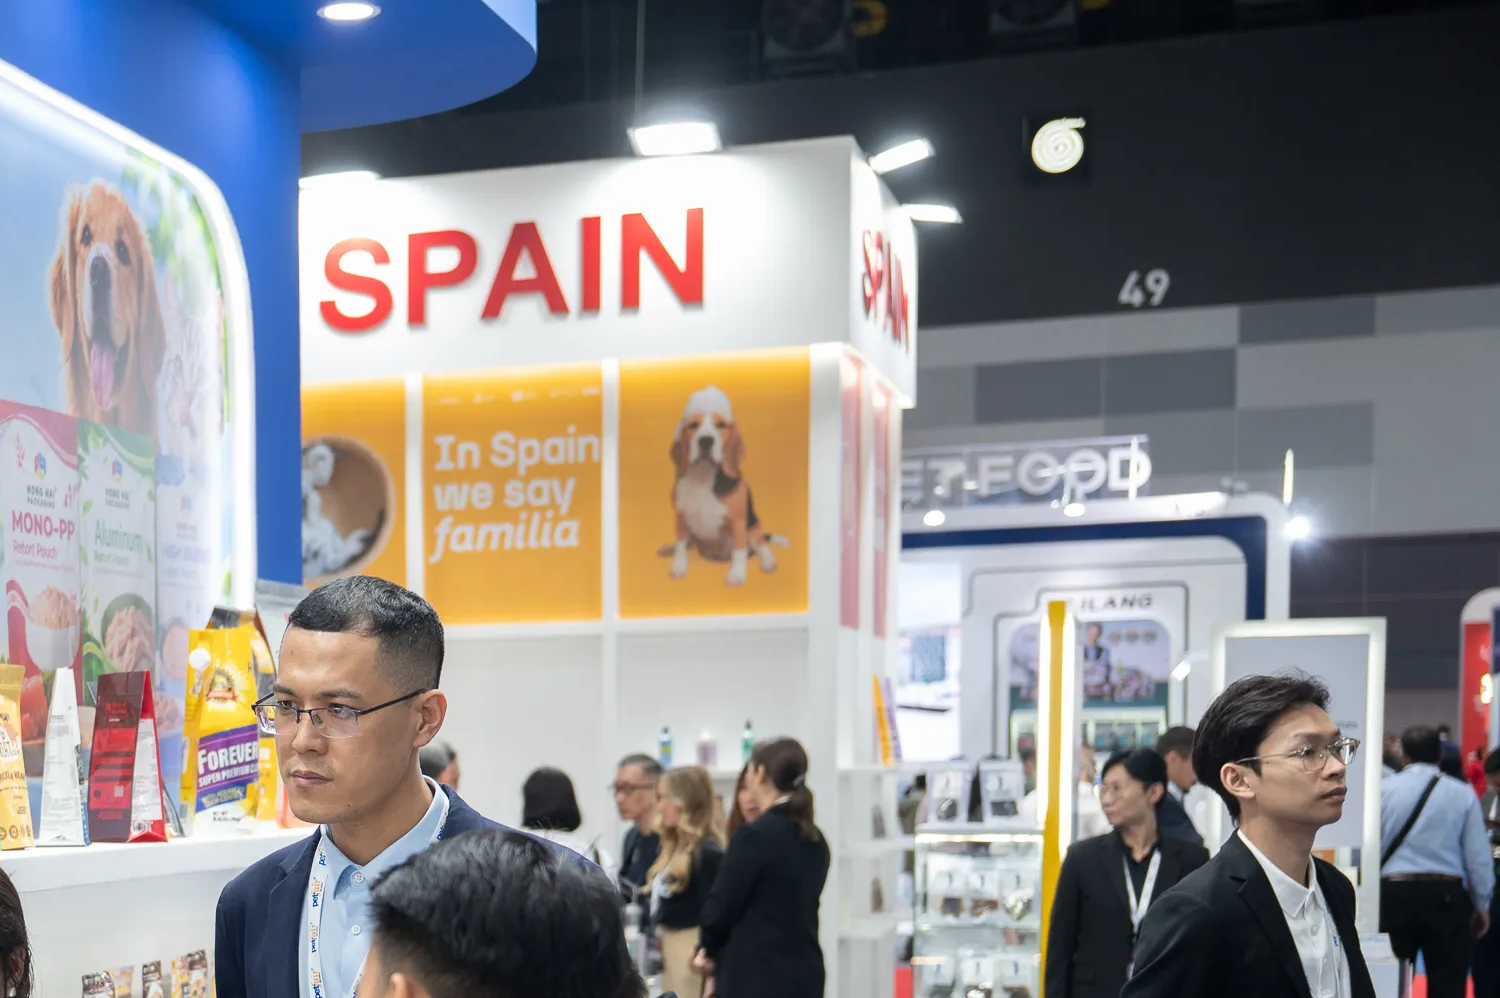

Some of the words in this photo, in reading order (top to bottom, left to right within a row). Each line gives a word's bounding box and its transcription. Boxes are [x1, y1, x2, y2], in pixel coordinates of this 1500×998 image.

[319, 207, 704, 333] SPAIN
[1118, 269, 1171, 306] 49
[434, 434, 481, 470] In
[490, 424, 600, 476] Spain
[978, 448, 1152, 497] FOOD
[434, 481, 494, 512] we
[504, 477, 576, 515] say
[12, 509, 75, 541] MONO-PP
[429, 509, 580, 564] familia
[198, 741, 258, 775] FOREVER
[198, 772, 221, 787] SUPER
